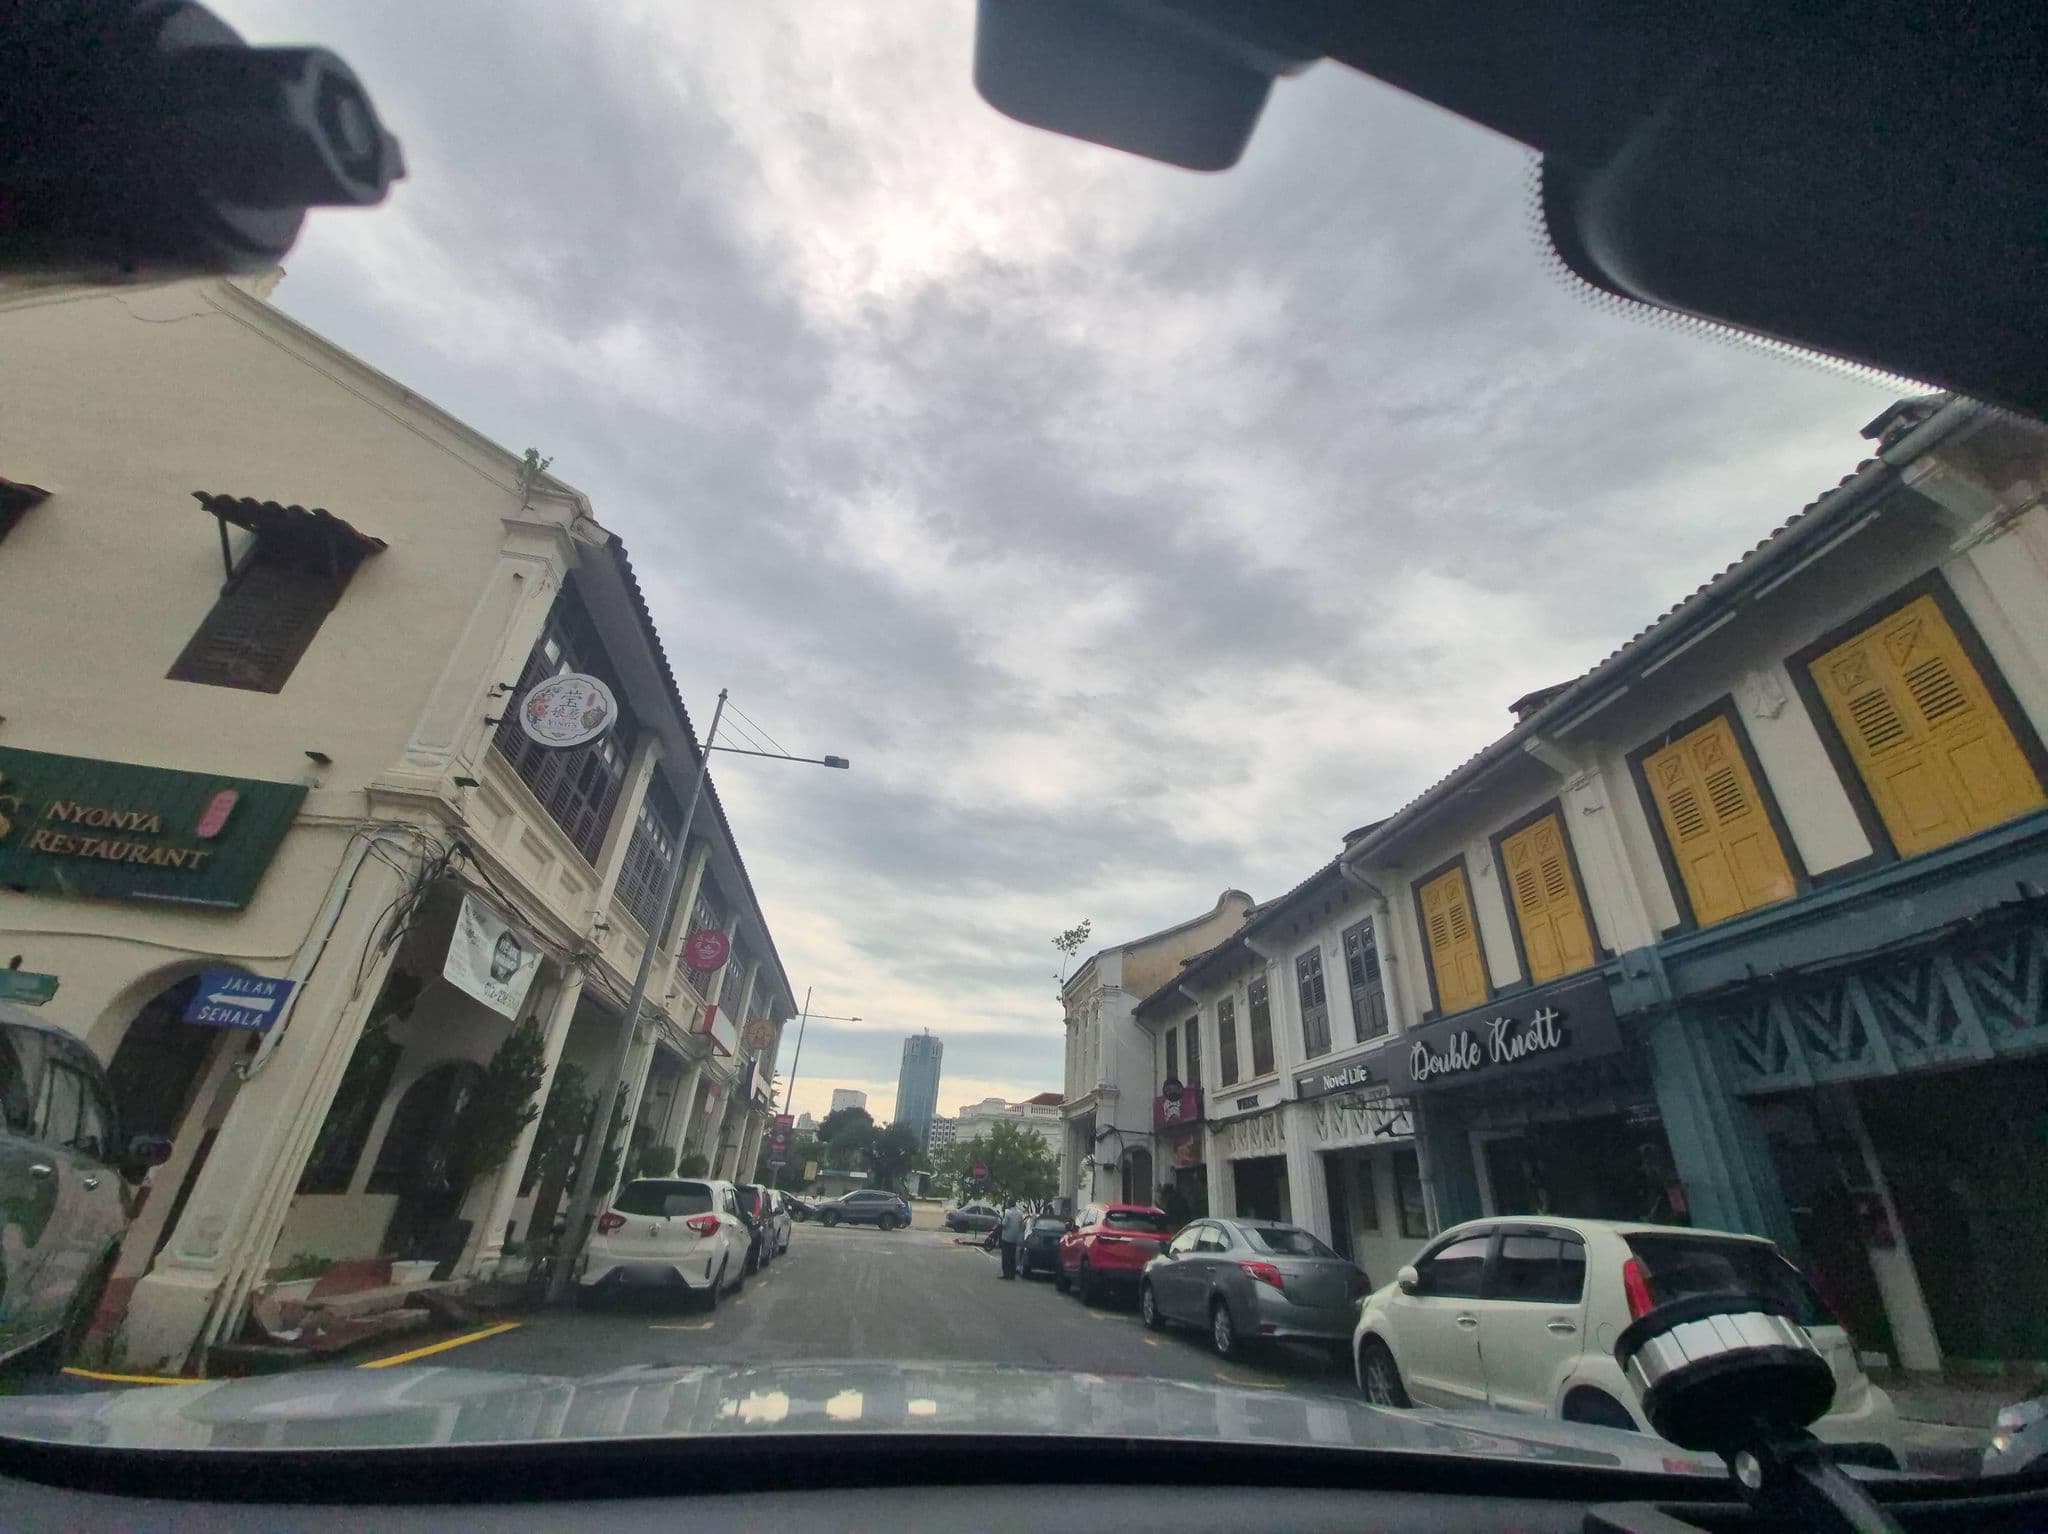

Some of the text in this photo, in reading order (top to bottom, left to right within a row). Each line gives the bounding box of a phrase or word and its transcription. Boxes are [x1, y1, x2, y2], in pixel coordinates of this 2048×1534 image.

[47, 801, 160, 833] NYONYA
[30, 829, 211, 869] RESTAURANT
[220, 976, 277, 995] JALAN
[198, 1005, 264, 1027] SEHALA
[1410, 1006, 1562, 1081] Double Knott
[1323, 1064, 1367, 1091] Novel Life
